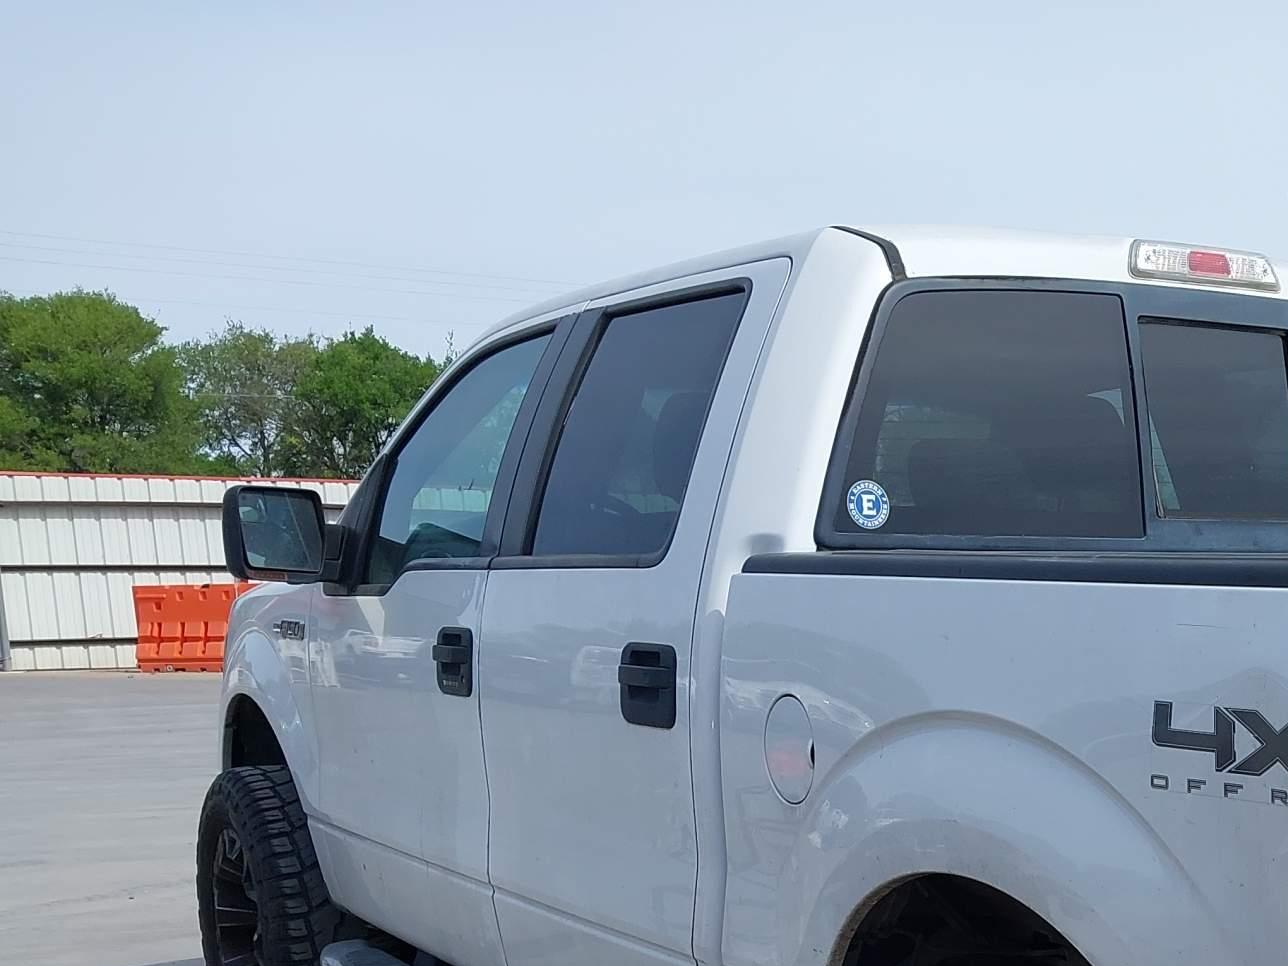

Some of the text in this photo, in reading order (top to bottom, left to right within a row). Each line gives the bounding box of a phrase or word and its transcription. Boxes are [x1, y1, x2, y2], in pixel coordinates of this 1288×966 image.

[852, 482, 883, 496] EASTERN
[860, 494, 877, 516] E
[1150, 773, 1244, 798] OFF
